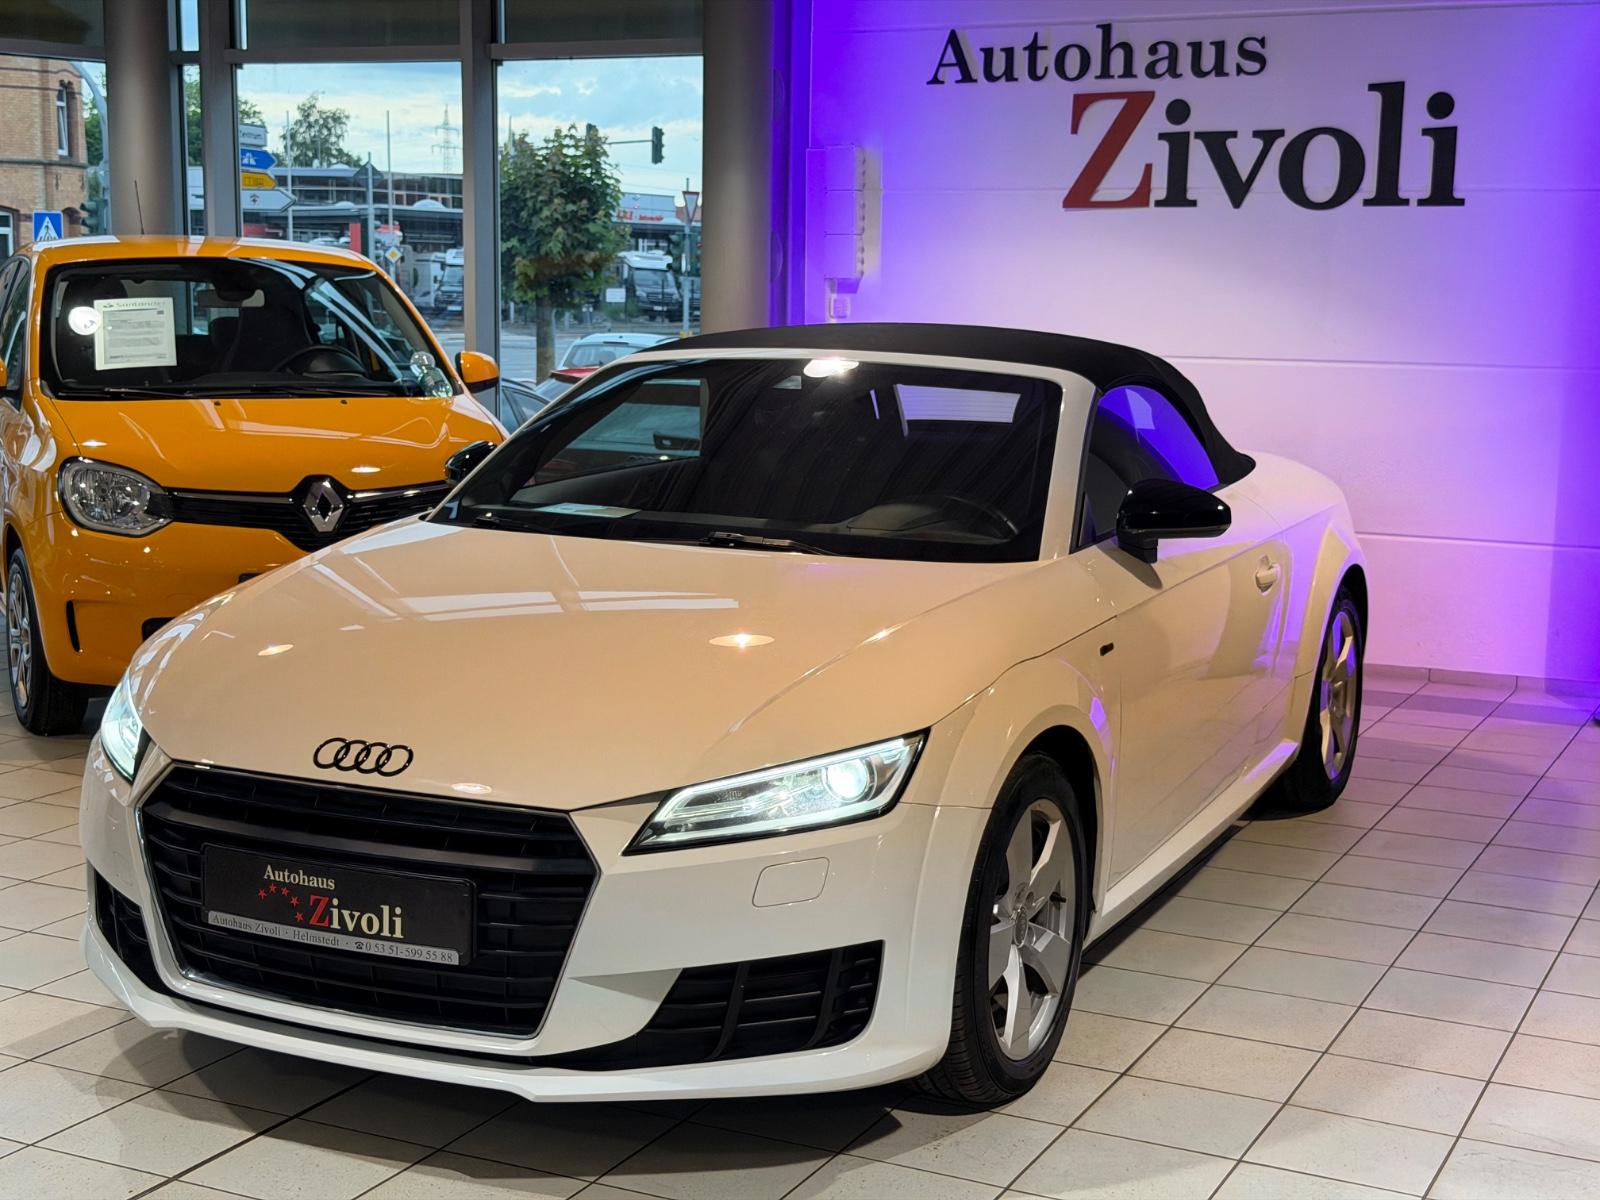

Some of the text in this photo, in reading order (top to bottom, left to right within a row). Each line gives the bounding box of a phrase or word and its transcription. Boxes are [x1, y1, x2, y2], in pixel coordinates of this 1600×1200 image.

[926, 23, 1268, 85] Autohaus
[1061, 80, 1466, 212] Zivoli
[263, 864, 336, 890] Autohaus
[213, 914, 252, 931] Autohaus
[254, 922, 282, 938] Zivoli
[293, 930, 340, 947] Helmstedt
[374, 943, 386, 954] 53
[388, 945, 423, 959] 51-599
[425, 949, 438, 961] 55
[440, 951, 453, 963] 88
[309, 894, 404, 939] Zivoli
